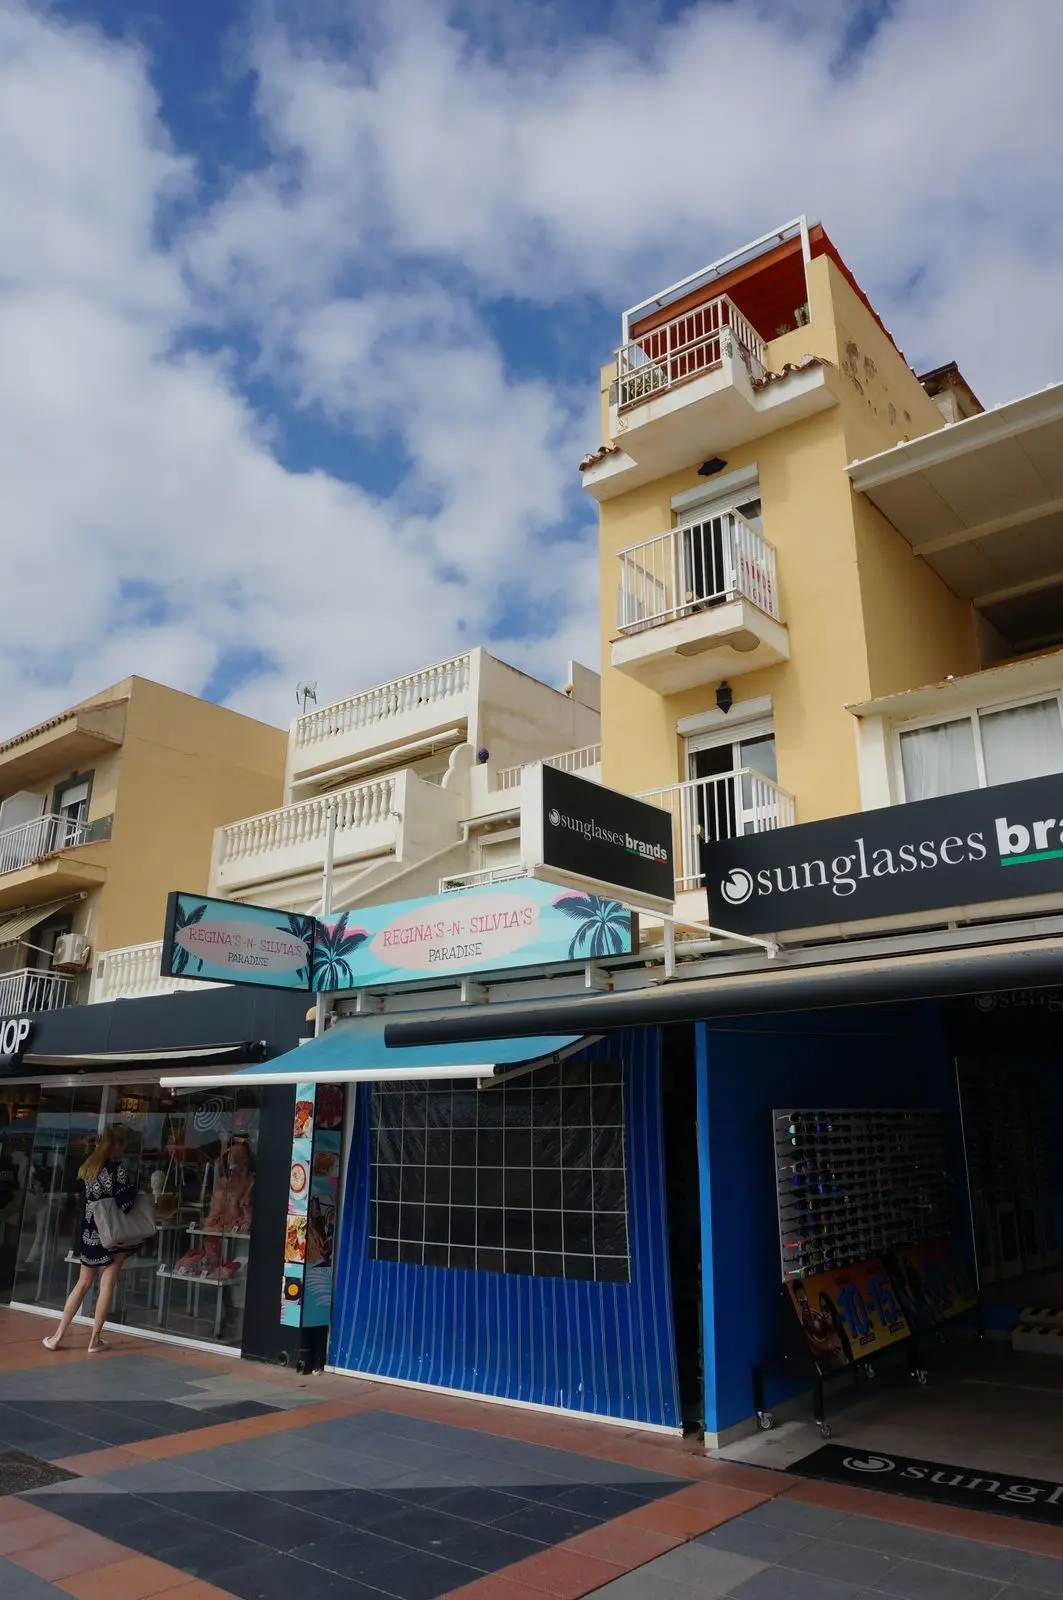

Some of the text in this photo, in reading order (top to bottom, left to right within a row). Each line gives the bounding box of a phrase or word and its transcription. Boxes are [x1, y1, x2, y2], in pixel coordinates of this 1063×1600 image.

[561, 814, 668, 861] sunglasses brands
[757, 816, 1063, 897] sunglasses br
[188, 927, 242, 948] REGINA'S
[259, 939, 304, 958] SILVIA'S
[383, 921, 445, 947] REGINA'S
[470, 907, 533, 934] SILVIA'S
[227, 952, 269, 967] PARADISE
[428, 942, 483, 963] PARADISE
